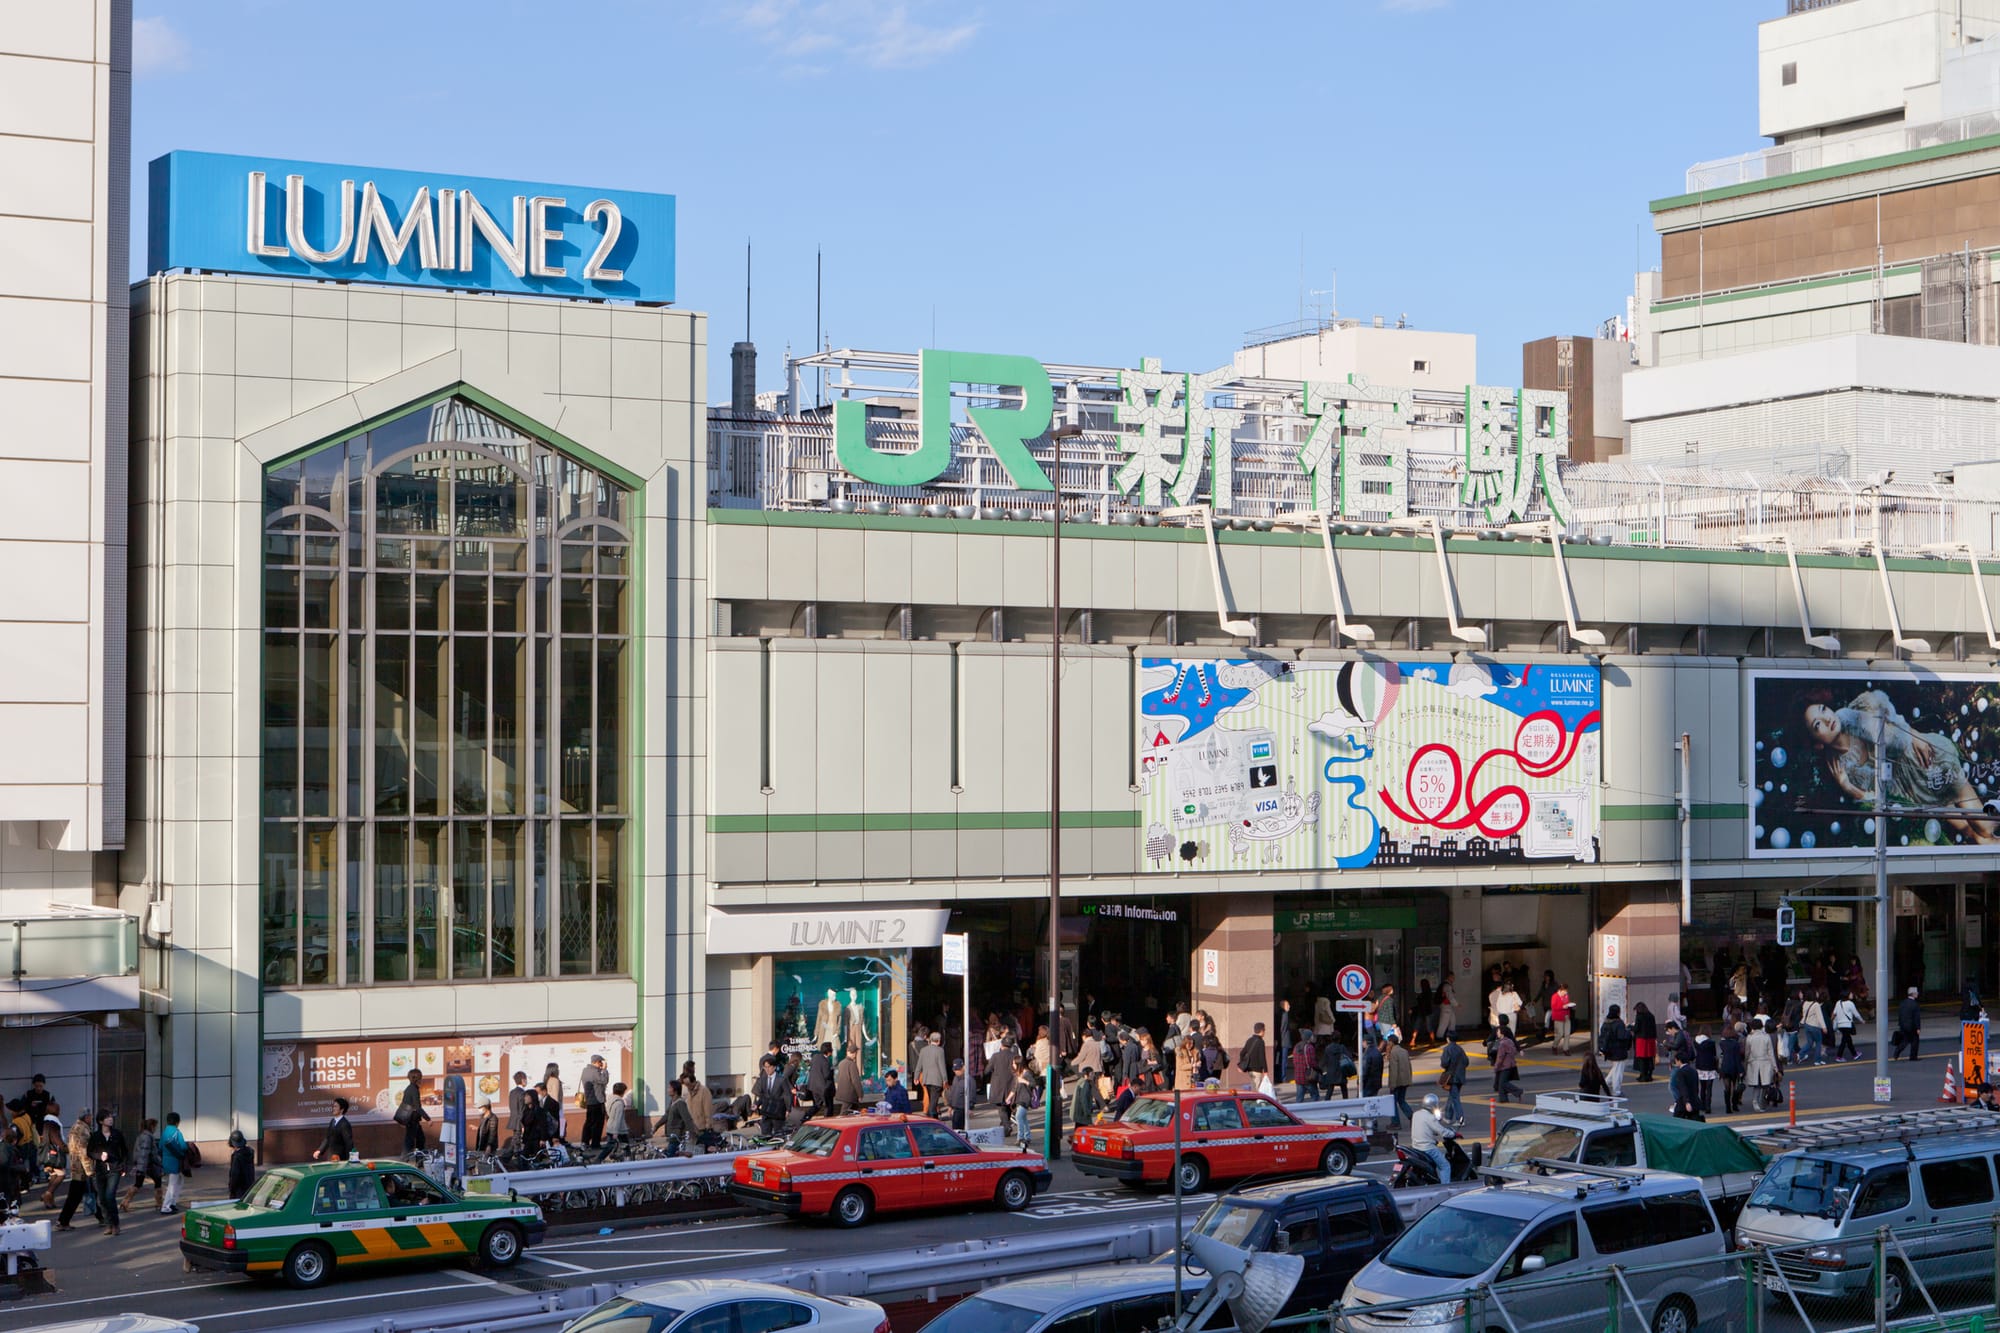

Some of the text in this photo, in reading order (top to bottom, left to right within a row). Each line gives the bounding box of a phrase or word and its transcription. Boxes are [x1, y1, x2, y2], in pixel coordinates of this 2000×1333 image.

[247, 171, 624, 280] LUMINE 2
[836, 349, 1570, 526] JR 新宿駅
[1550, 679, 1595, 693] LUMINE
[1550, 699, 1595, 708] www.lumine.ne.jp
[1522, 733, 1556, 748] 定期券
[1199, 747, 1229, 761] LUMINE
[1420, 775, 1446, 793] 5%
[1256, 800, 1278, 813] VISA
[1419, 797, 1446, 809] OFF
[1490, 810, 1514, 825] 無料
[1124, 904, 1177, 921] Information
[1293, 913, 1311, 926] JR
[790, 918, 906, 946] LUMINE 2
[1970, 1030, 1983, 1046] 50
[310, 1051, 361, 1069] meshi
[310, 1068, 356, 1082] mase
